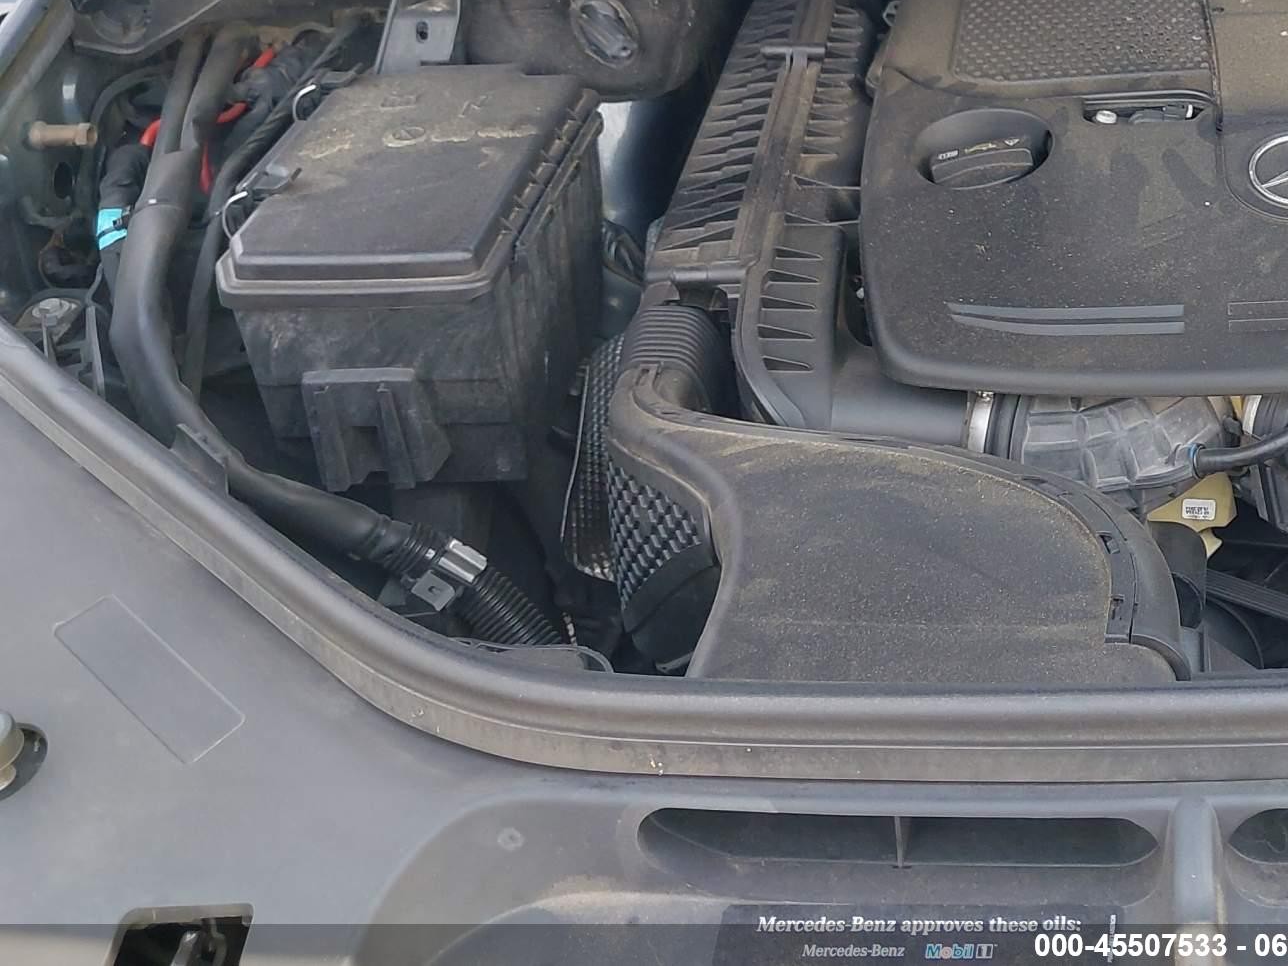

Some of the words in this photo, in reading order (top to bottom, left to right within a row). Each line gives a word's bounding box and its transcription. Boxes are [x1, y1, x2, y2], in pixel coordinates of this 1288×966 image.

[755, 915, 897, 933] Mercedes-Benz
[900, 918, 984, 936] approves
[988, 916, 1038, 932] these
[1041, 915, 1082, 932] oils:
[802, 943, 905, 959] Mercedes-Benz
[925, 944, 974, 959] Mobil
